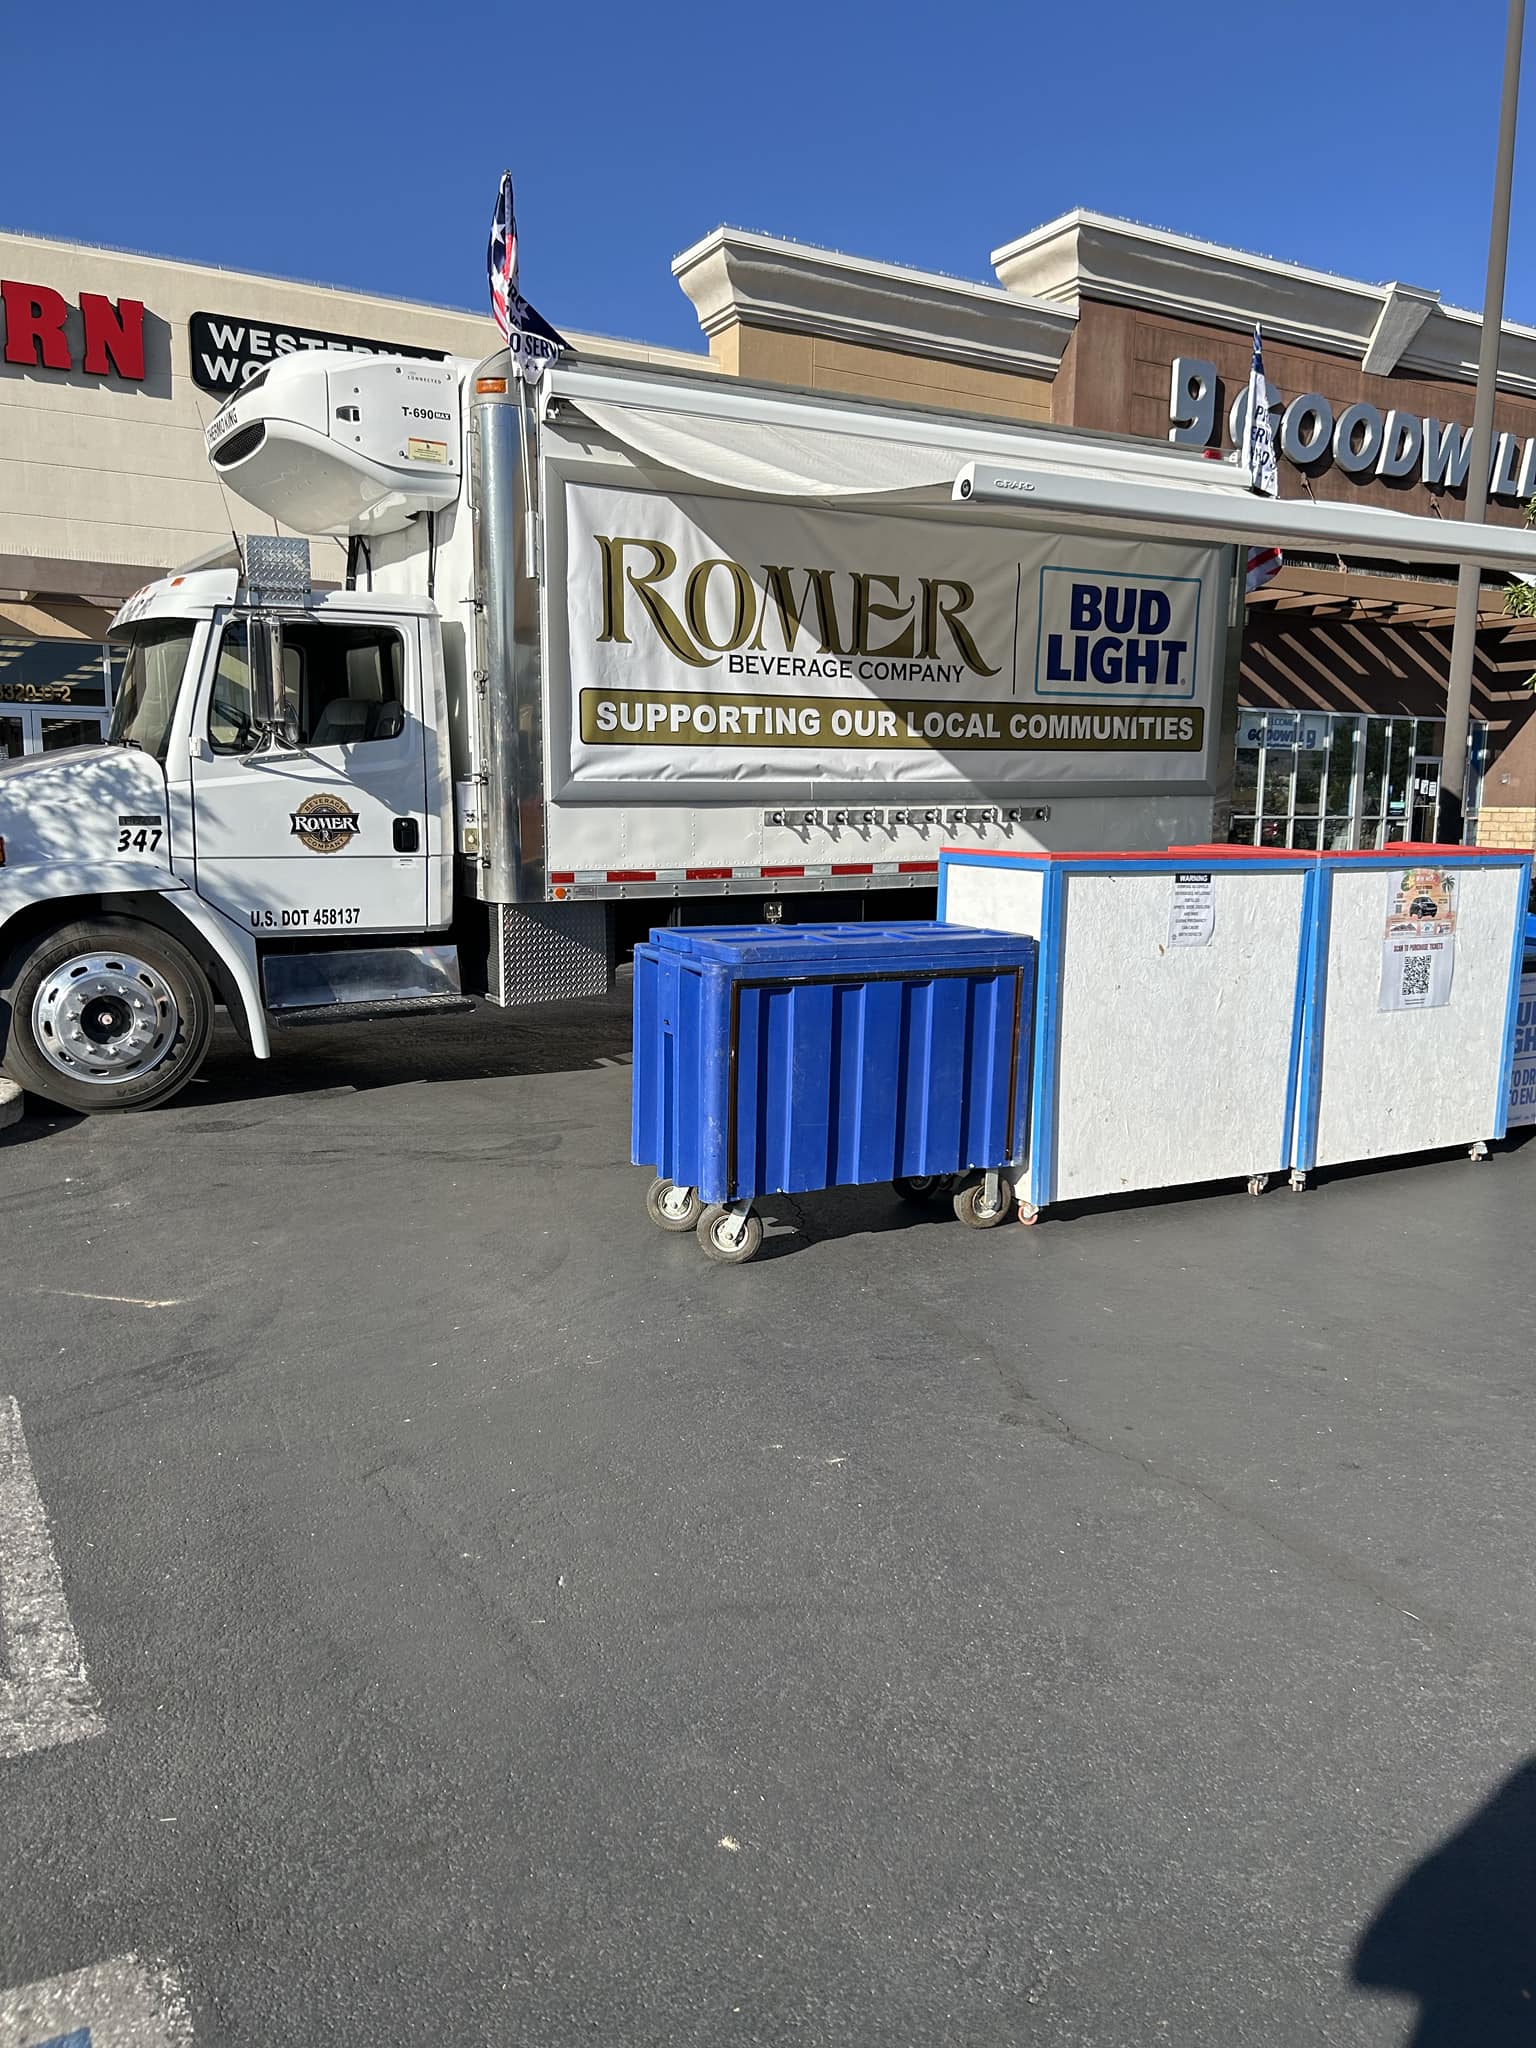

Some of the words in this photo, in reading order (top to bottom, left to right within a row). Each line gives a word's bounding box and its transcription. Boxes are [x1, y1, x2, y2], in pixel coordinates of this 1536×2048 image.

[593, 535, 1002, 679] ROMER
[1070, 583, 1171, 635] BUD
[729, 654, 853, 680] BEVERAGE
[858, 661, 965, 684] COMPANY
[1045, 634, 1188, 685] LIGHT
[597, 701, 821, 738] SUPPORTING
[830, 708, 898, 739] OUR
[907, 709, 1001, 741] LOCAL
[1008, 712, 1194, 742] COMMUNITIES
[304, 799, 345, 811] BEVERAGE
[295, 816, 357, 832] ROMER
[118, 829, 163, 852] 347
[306, 838, 345, 849] COMPANY
[1179, 874, 1209, 882] WARNING
[251, 910, 277, 927] U.S.
[281, 909, 309, 926] DOT
[313, 908, 360, 925] 458137
